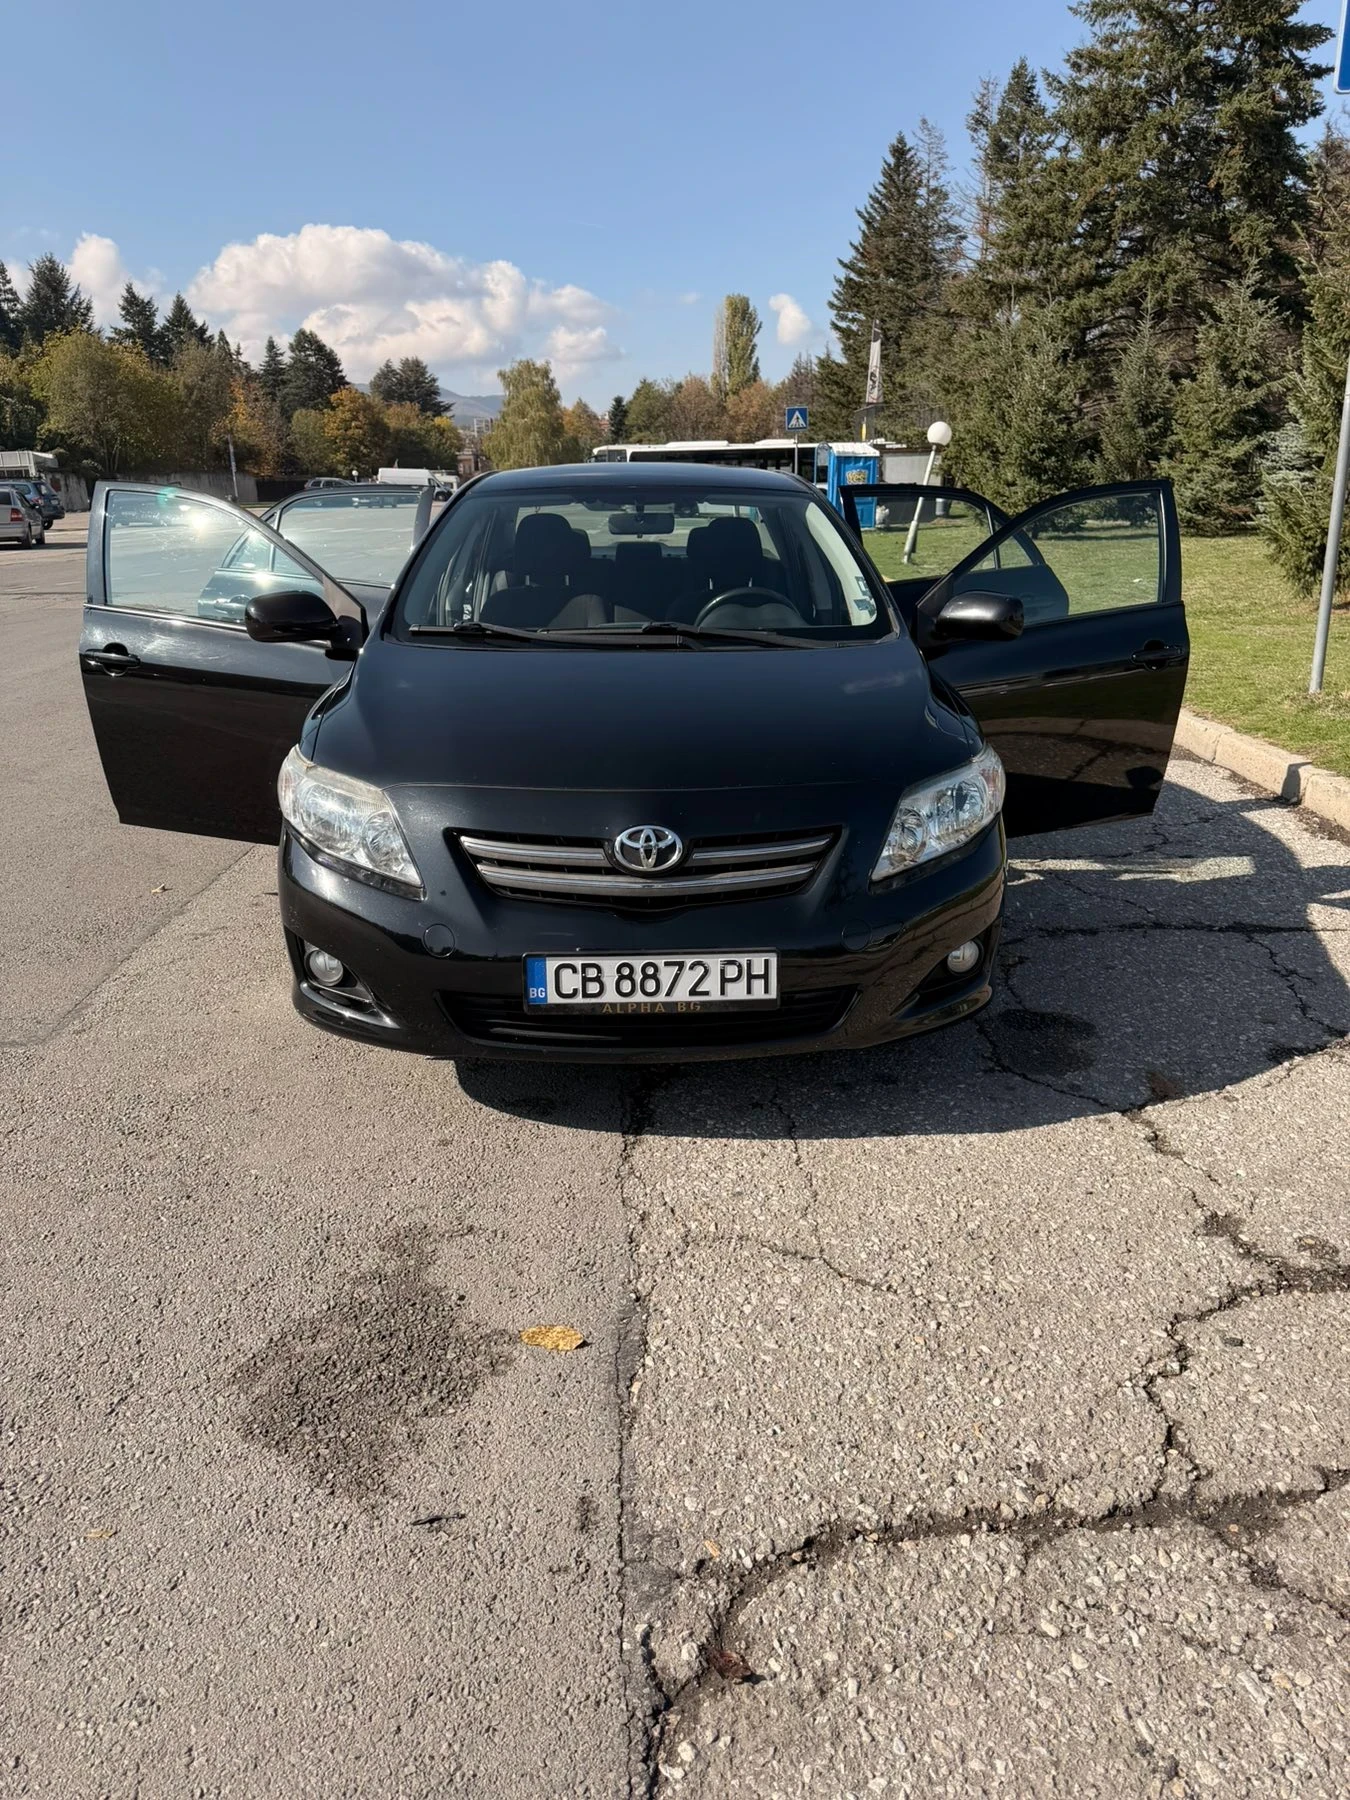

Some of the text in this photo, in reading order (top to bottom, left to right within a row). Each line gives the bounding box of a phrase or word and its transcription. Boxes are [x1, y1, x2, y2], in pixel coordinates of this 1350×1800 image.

[554, 958, 770, 999] CB 8872 PH
[529, 987, 546, 998] BG
[602, 1001, 701, 1013] ALPHA BG
